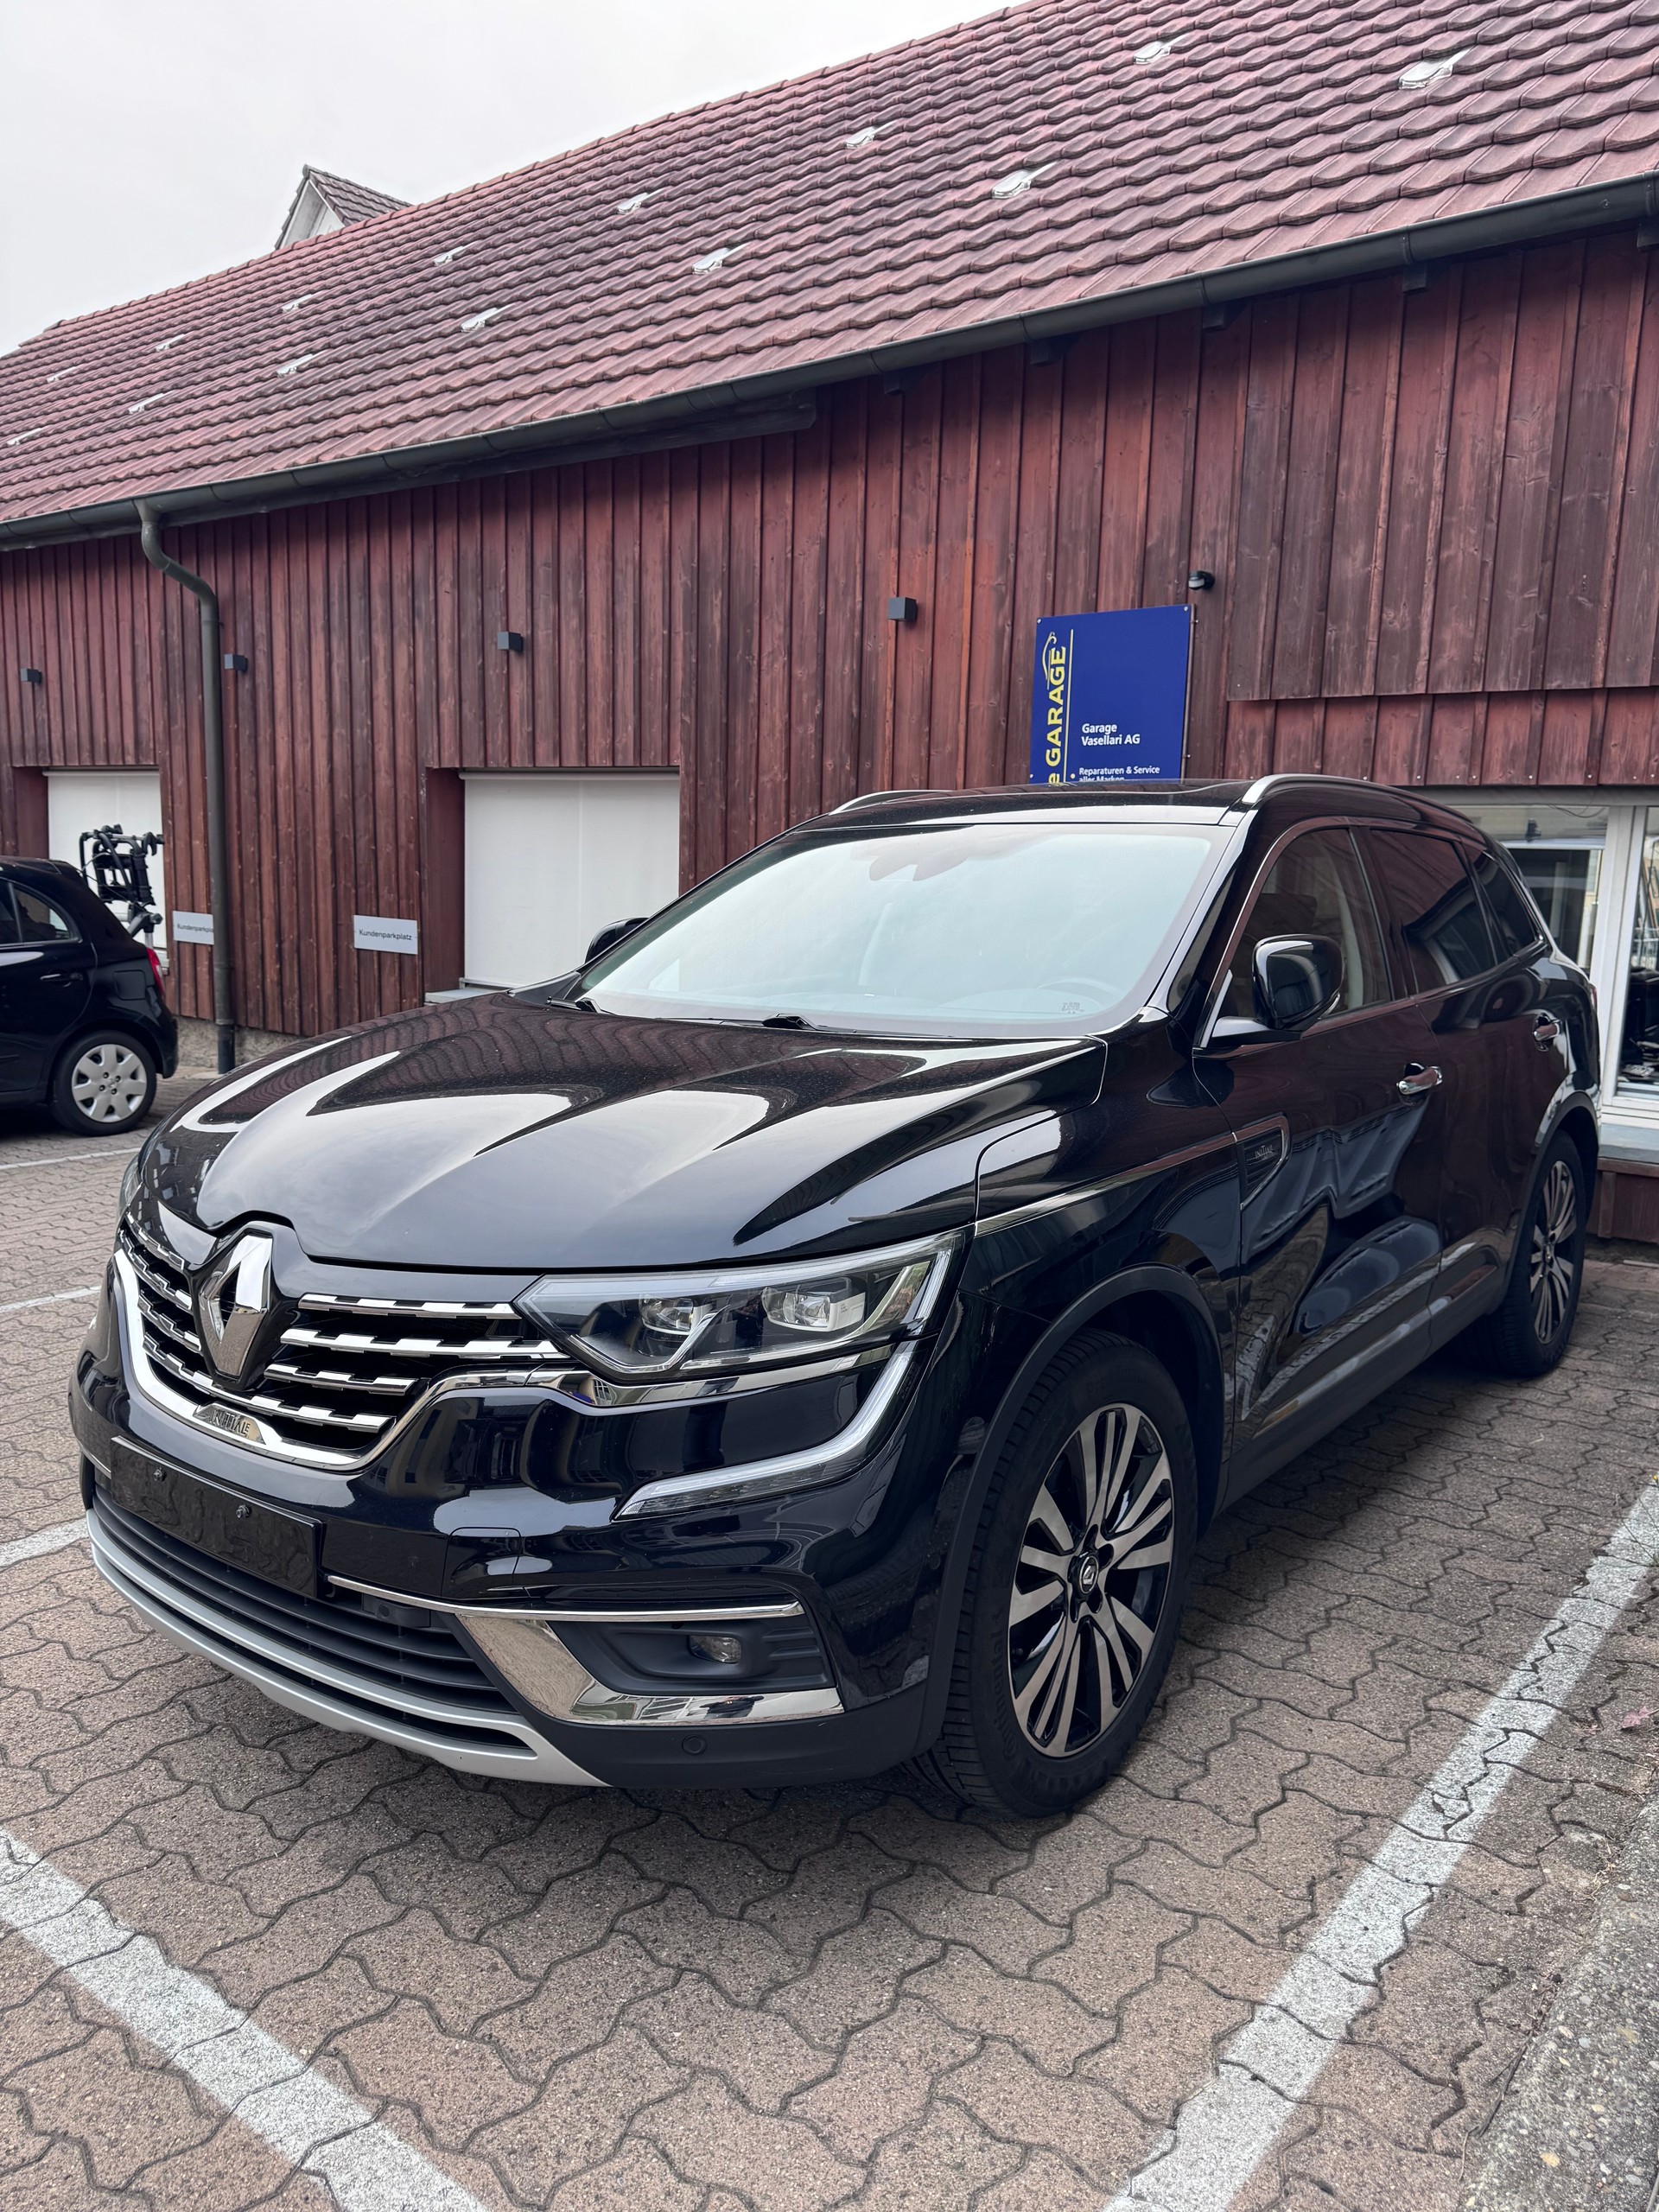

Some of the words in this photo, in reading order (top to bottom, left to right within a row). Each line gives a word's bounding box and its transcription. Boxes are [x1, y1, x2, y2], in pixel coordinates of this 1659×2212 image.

[1046, 646, 1066, 767] GARAGE
[1082, 723, 1117, 734] Garage
[1081, 734, 1122, 746] Vasellari
[1124, 734, 1141, 744] AG
[1078, 767, 1124, 776] Reparaturen
[1126, 766, 1133, 774] &
[1133, 765, 1160, 774] Service
[359, 929, 412, 940] Kundenparkplatz
